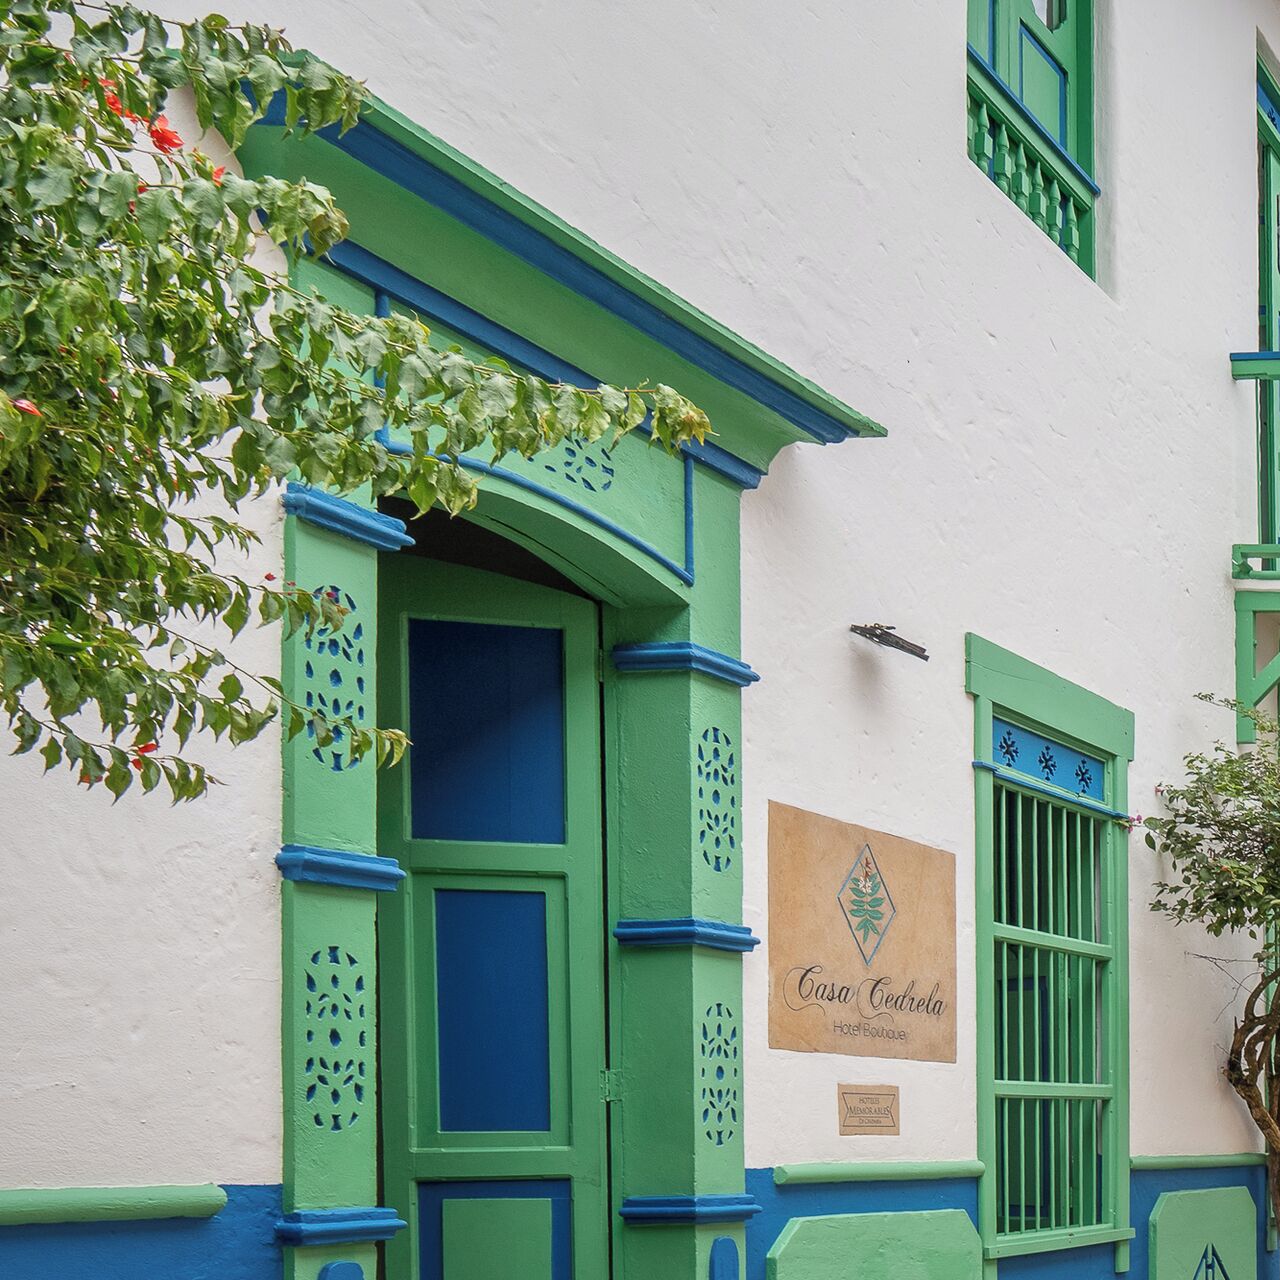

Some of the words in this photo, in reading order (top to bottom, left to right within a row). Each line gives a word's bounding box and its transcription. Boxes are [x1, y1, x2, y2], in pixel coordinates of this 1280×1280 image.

[783, 965, 855, 1016] Casa
[857, 976, 947, 1024] Cedrela
[833, 1020, 861, 1036] Hotel
[863, 1022, 907, 1042] Boutique
